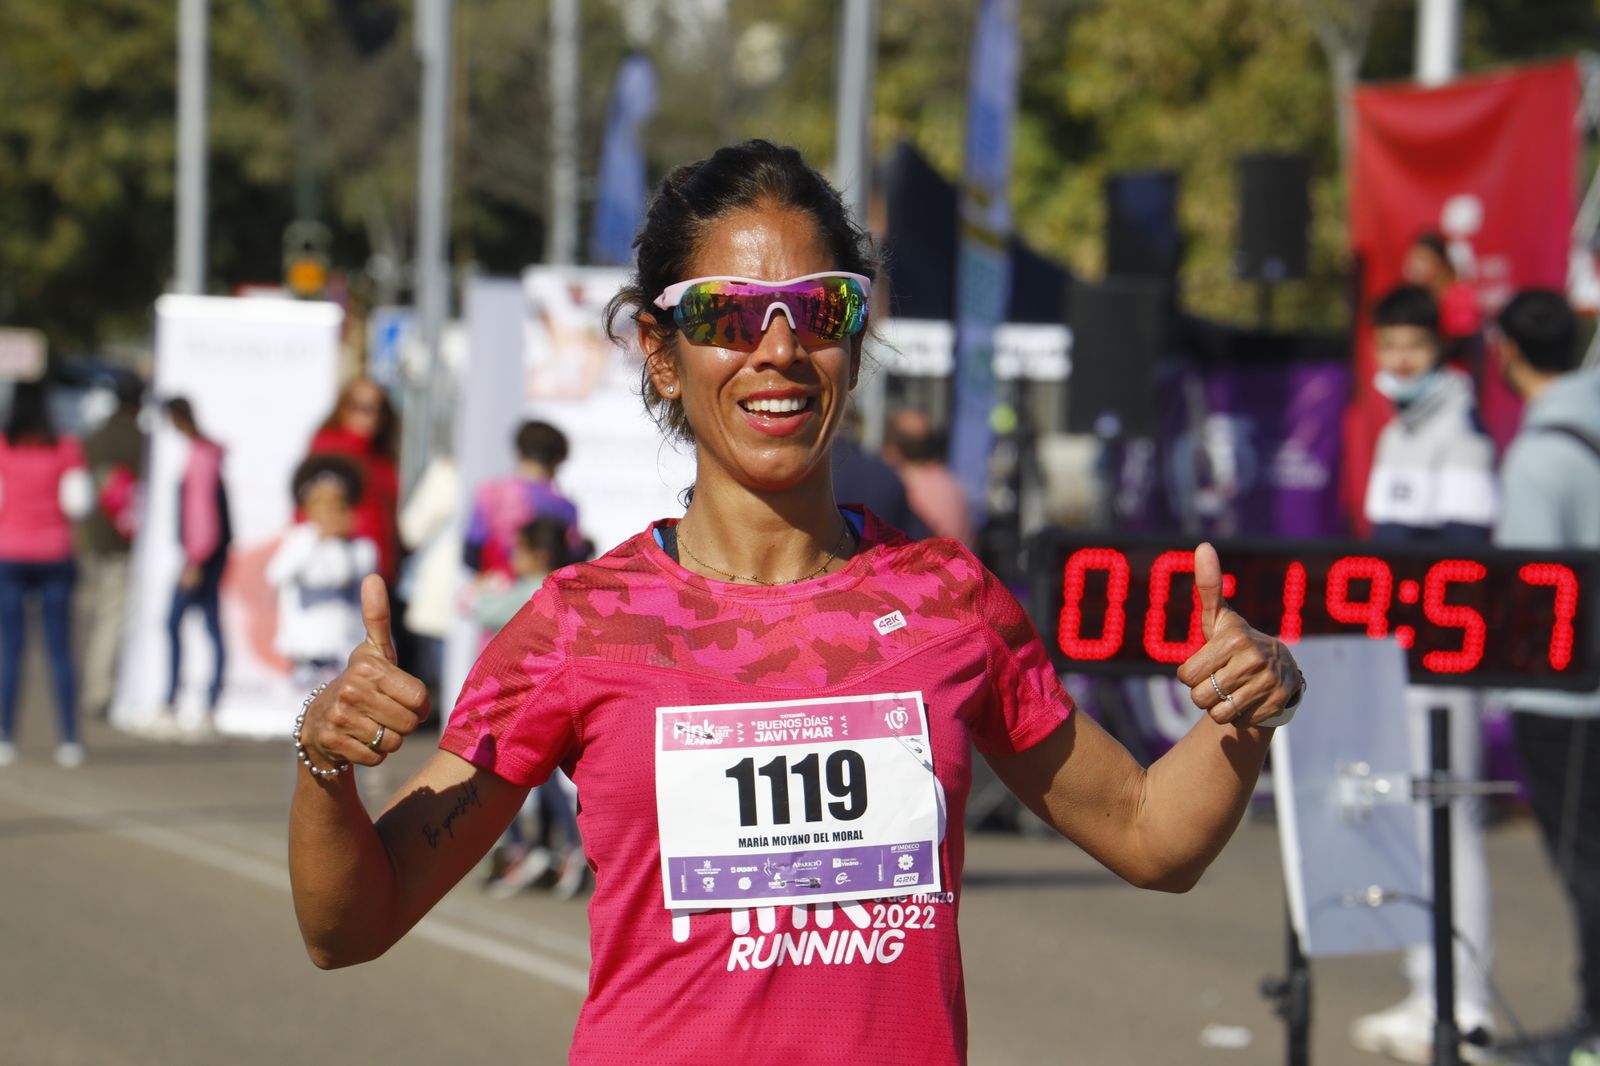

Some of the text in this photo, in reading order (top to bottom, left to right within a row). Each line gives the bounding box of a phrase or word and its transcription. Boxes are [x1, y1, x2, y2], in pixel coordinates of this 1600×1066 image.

[878, 614, 901, 629] 42K
[754, 726, 833, 743] JAVI Y MAR
[725, 749, 868, 827] 1119
[738, 829, 864, 849] MARÍA MOYANO DEL MORAL
[872, 904, 936, 929] 2022
[727, 930, 906, 971] RUNNING
